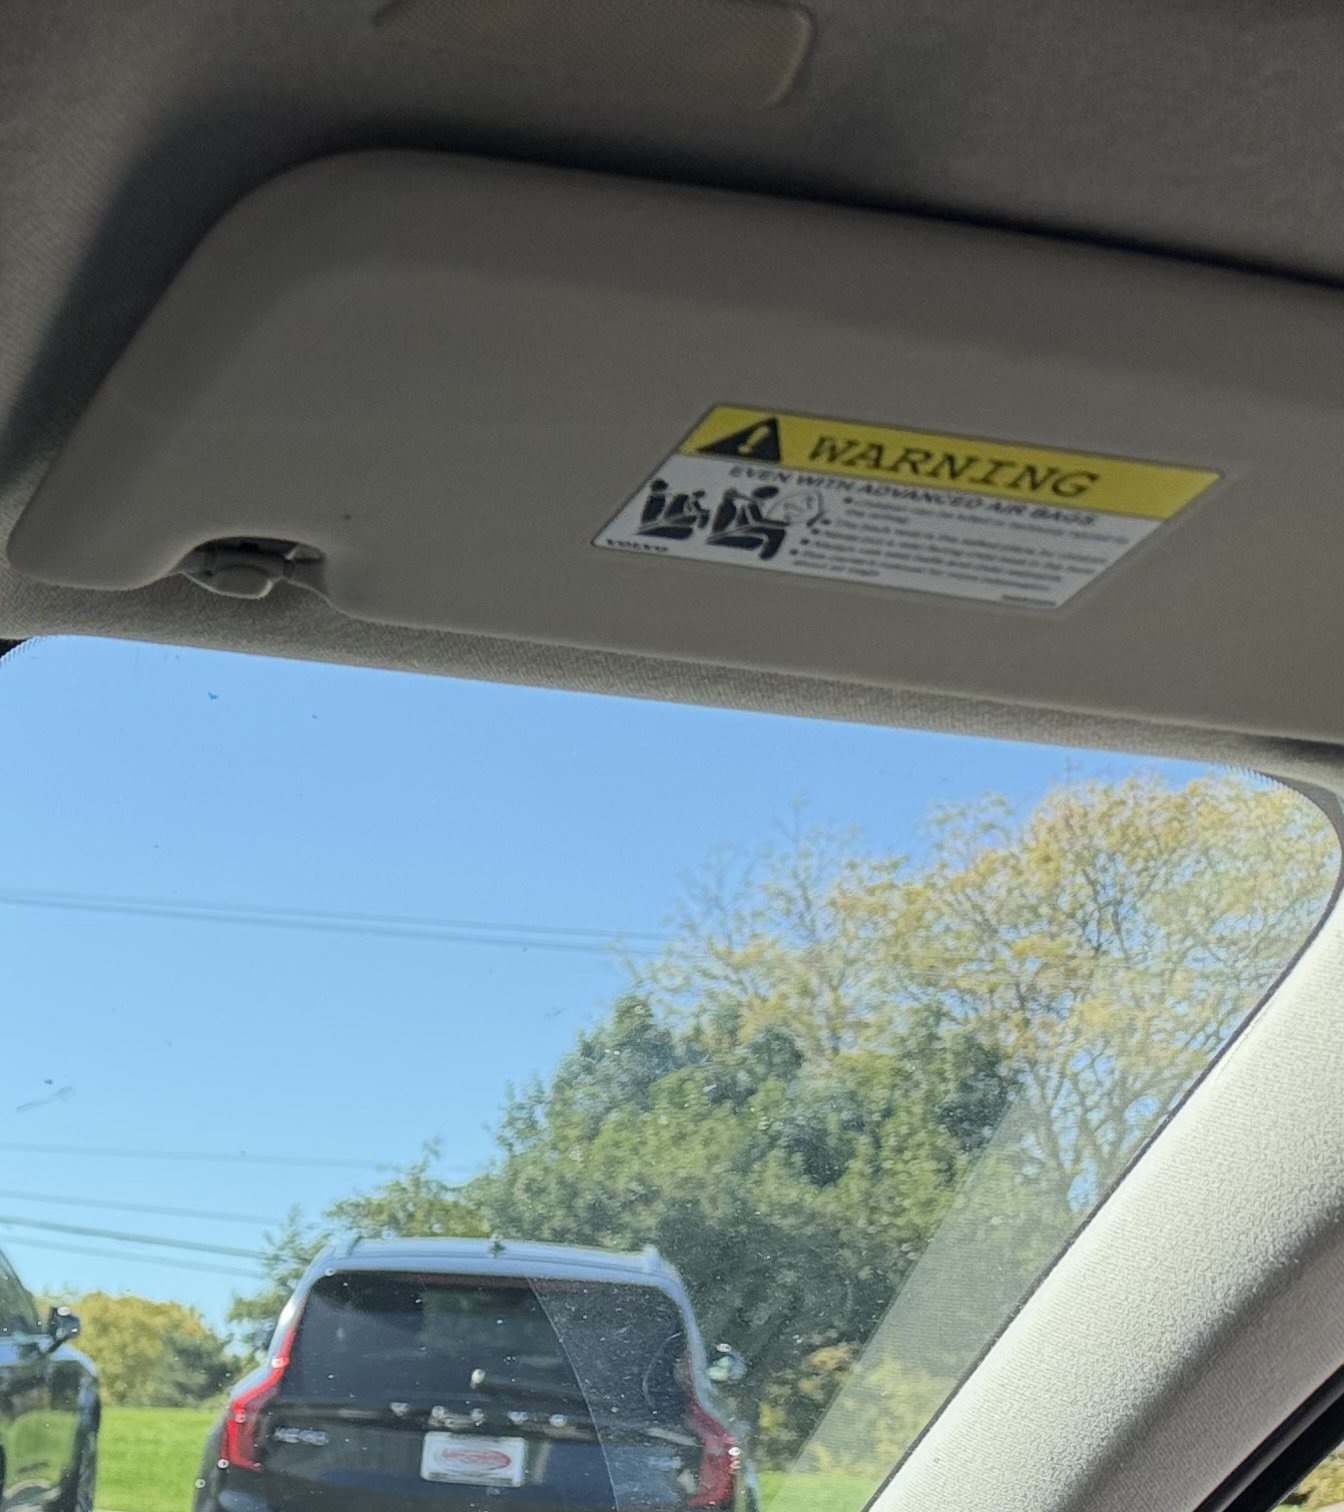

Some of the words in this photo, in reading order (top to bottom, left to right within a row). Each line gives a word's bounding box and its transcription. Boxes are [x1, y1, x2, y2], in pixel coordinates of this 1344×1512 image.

[728, 466, 792, 484] EVEN
[796, 474, 855, 491] WITH
[853, 482, 983, 511] ADVANCED
[987, 500, 1027, 517] AIR
[1029, 505, 1097, 527] BAGS
[808, 436, 1099, 497] WARNING
